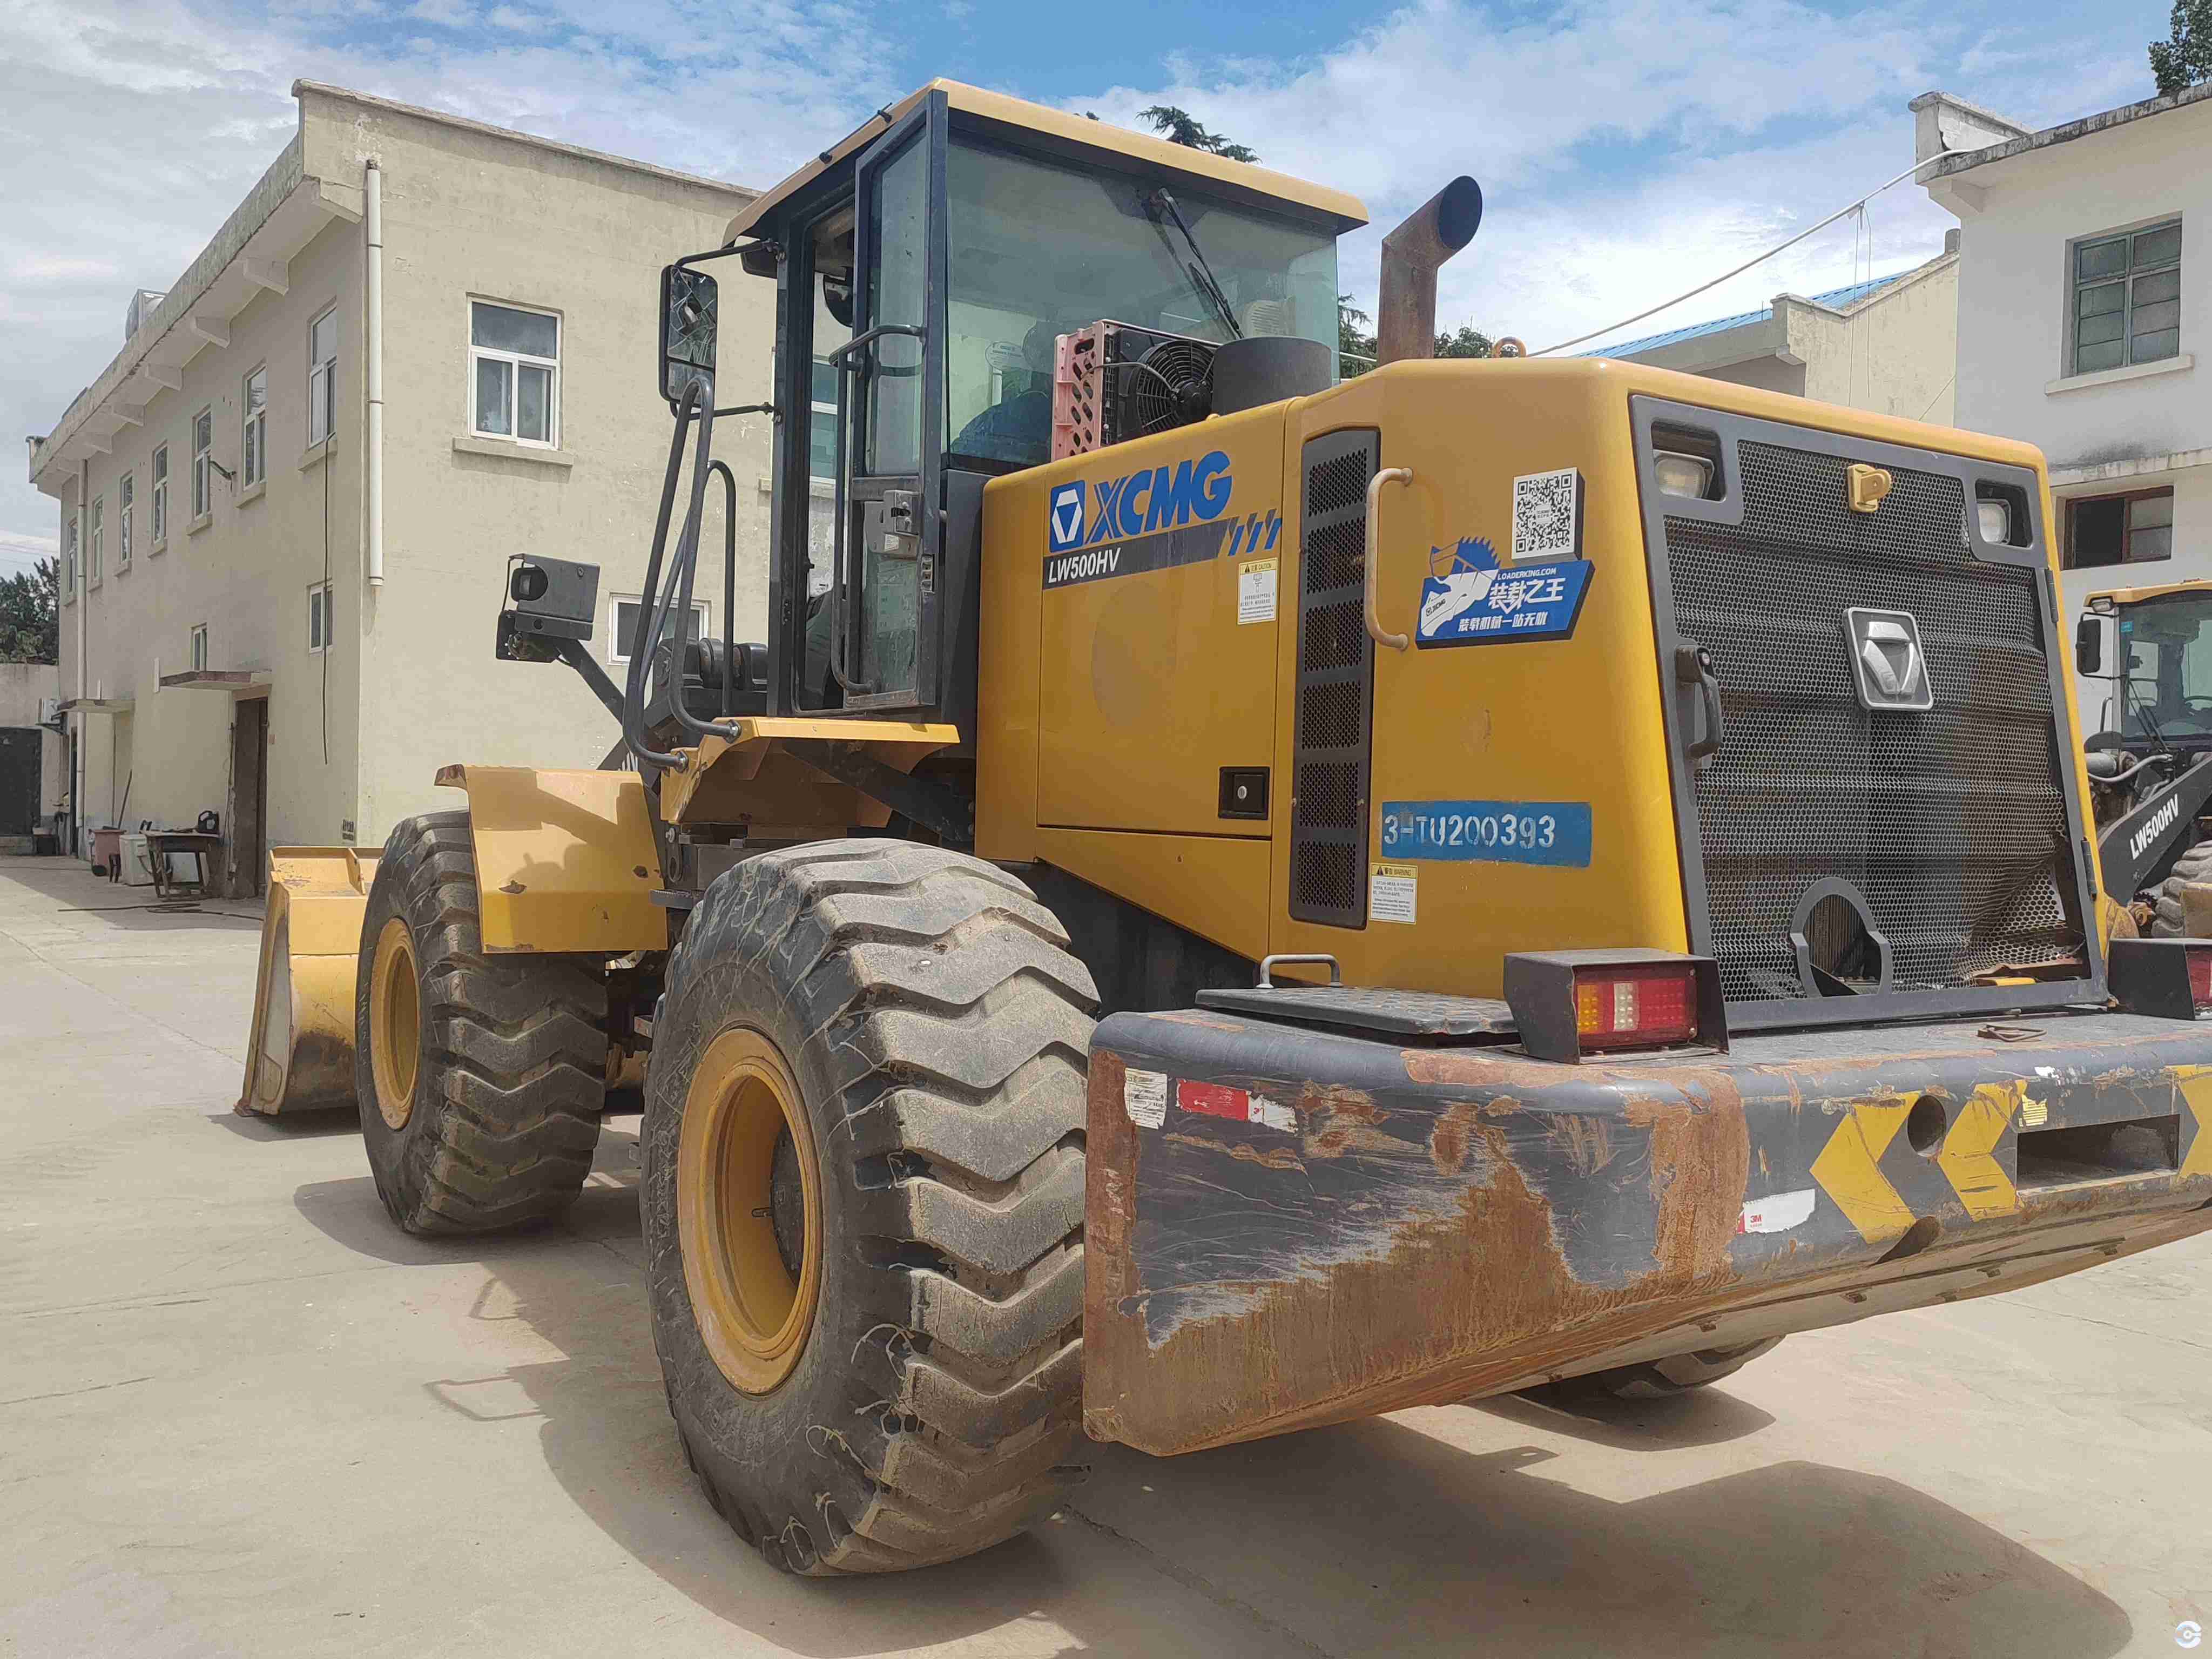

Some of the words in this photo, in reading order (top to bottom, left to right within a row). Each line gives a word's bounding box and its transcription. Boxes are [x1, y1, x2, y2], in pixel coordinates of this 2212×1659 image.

[1084, 450, 1232, 545] XCMG
[1048, 547, 1121, 584] LW500HV
[1498, 568, 1556, 581] LOADERKING.COM
[1488, 578, 1566, 615] 装载之王
[2129, 792, 2179, 860] LW500HV
[1750, 1214, 1762, 1223] 3M
